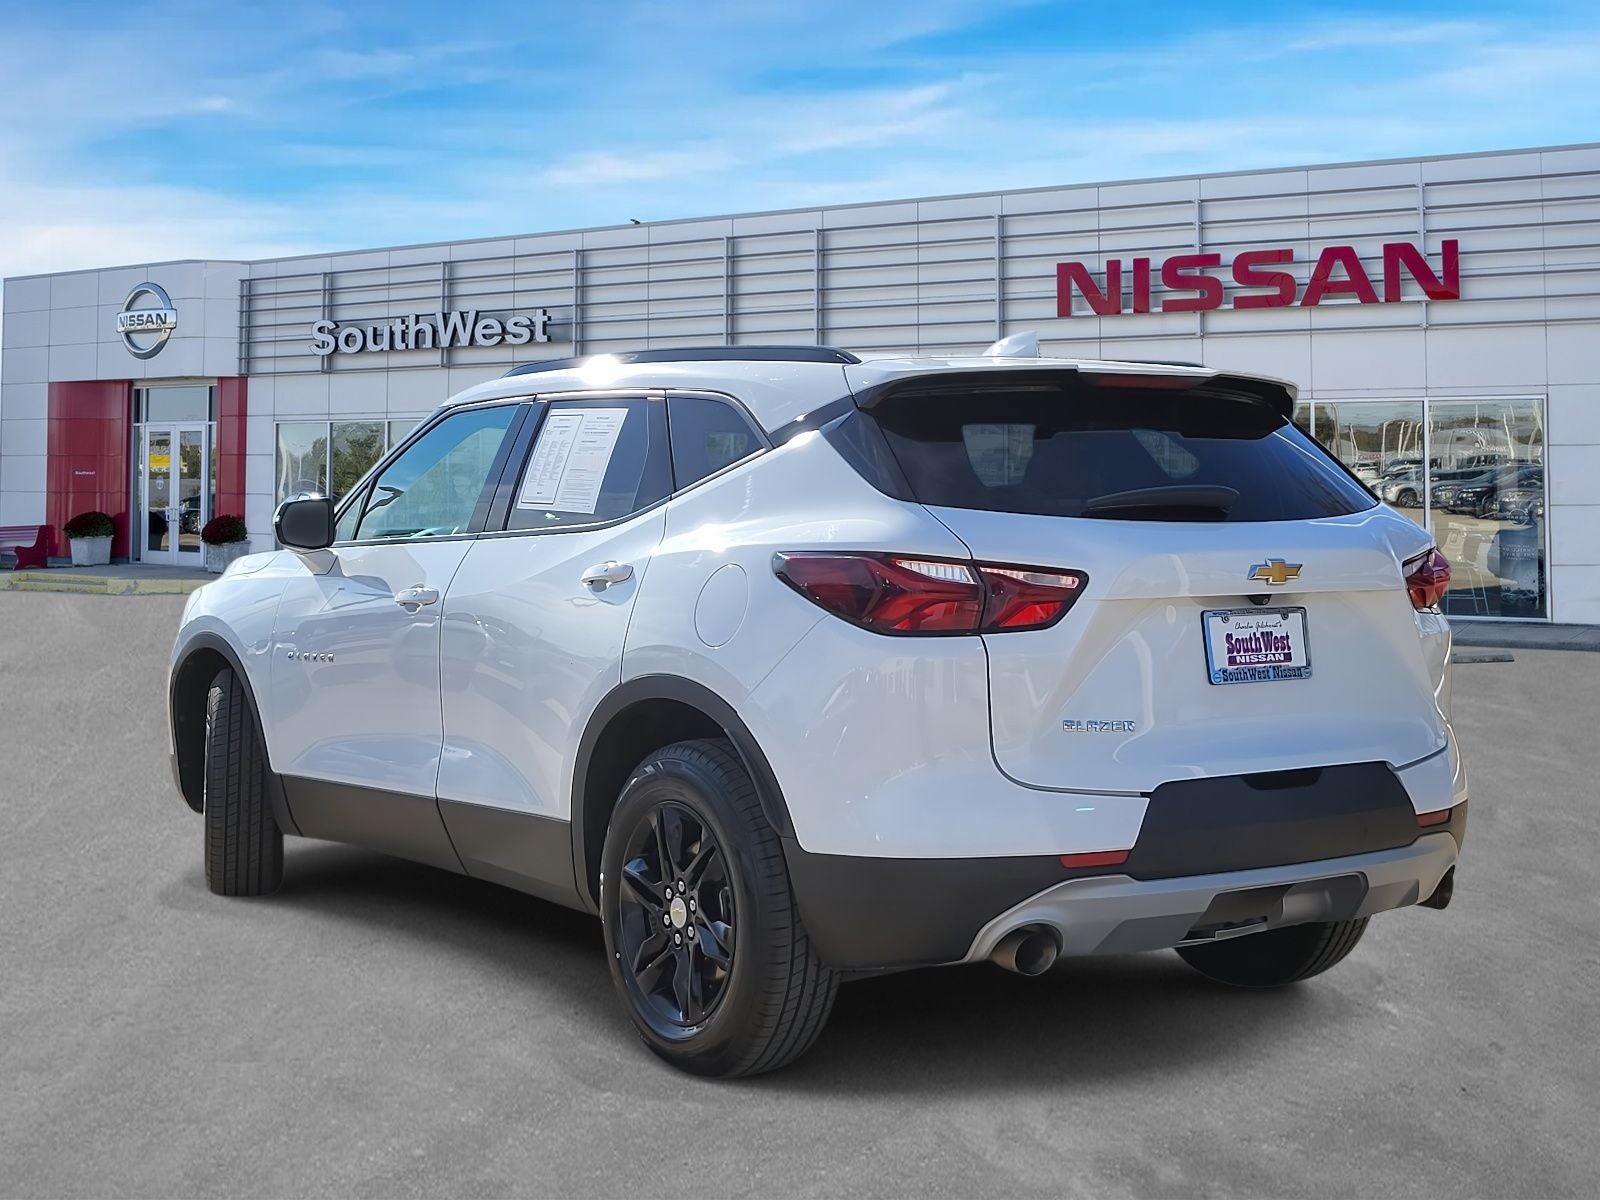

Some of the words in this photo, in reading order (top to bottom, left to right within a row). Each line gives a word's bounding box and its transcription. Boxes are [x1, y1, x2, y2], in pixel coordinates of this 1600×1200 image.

[1057, 239, 1460, 318] NISSAN
[118, 312, 168, 328] NISSAN
[309, 308, 552, 356] SouthWest
[1225, 631, 1292, 655] SouthWest
[1236, 653, 1285, 664] NISSAN
[1222, 667, 1271, 682] SouthWest
[1272, 665, 1303, 679] Nissan
[1062, 719, 1136, 733] BLAZER
